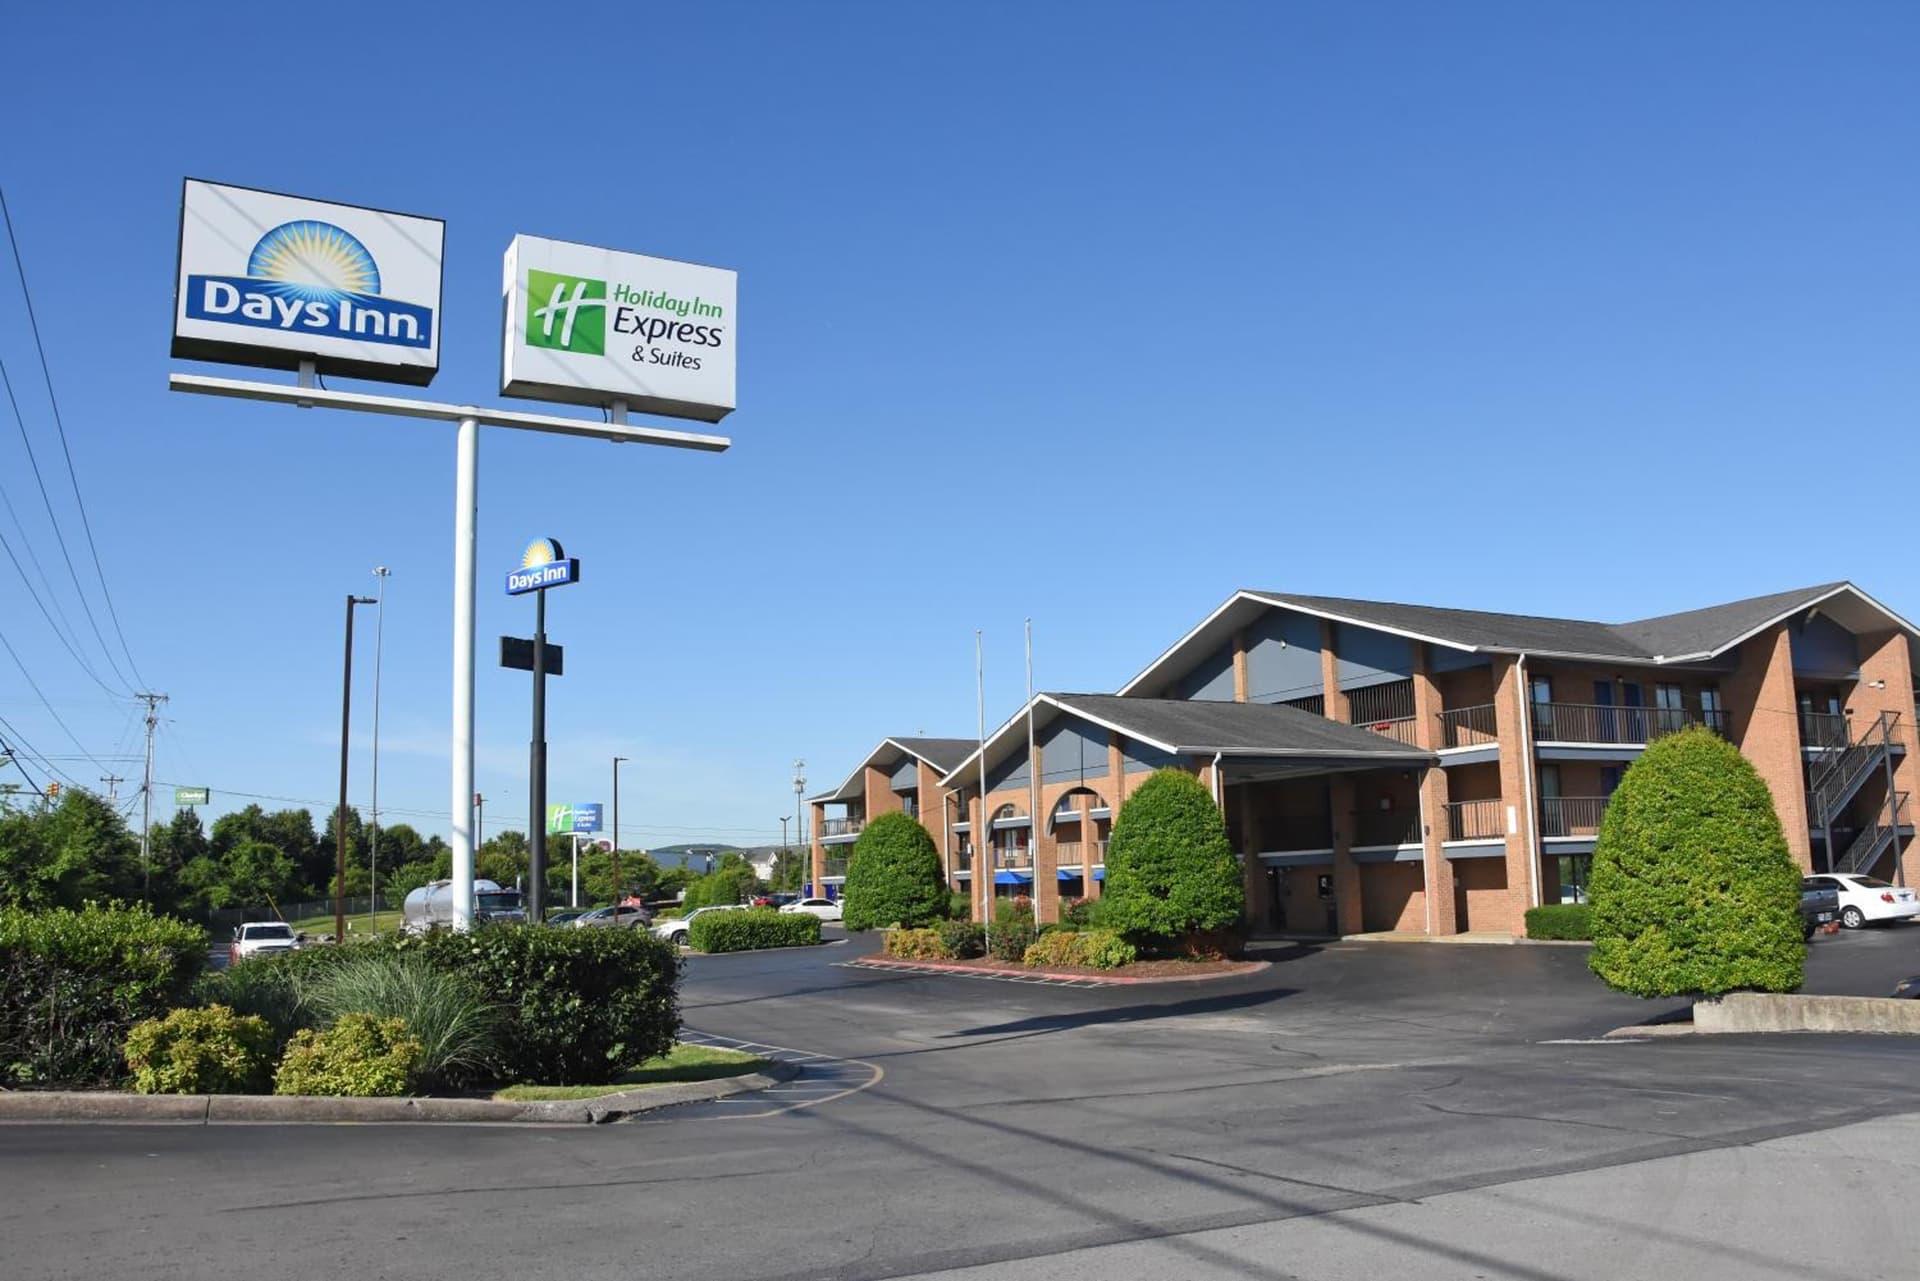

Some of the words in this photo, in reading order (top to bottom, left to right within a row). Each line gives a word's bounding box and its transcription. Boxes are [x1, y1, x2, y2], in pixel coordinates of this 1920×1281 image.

[203, 279, 330, 328] Days
[338, 300, 419, 341] Inn
[613, 283, 690, 318] Holiday
[693, 296, 723, 319] Inn
[613, 306, 724, 348] Express
[631, 344, 645, 363] &
[648, 347, 702, 371] Suites
[509, 572, 541, 590] Days
[543, 566, 566, 582] Inn
